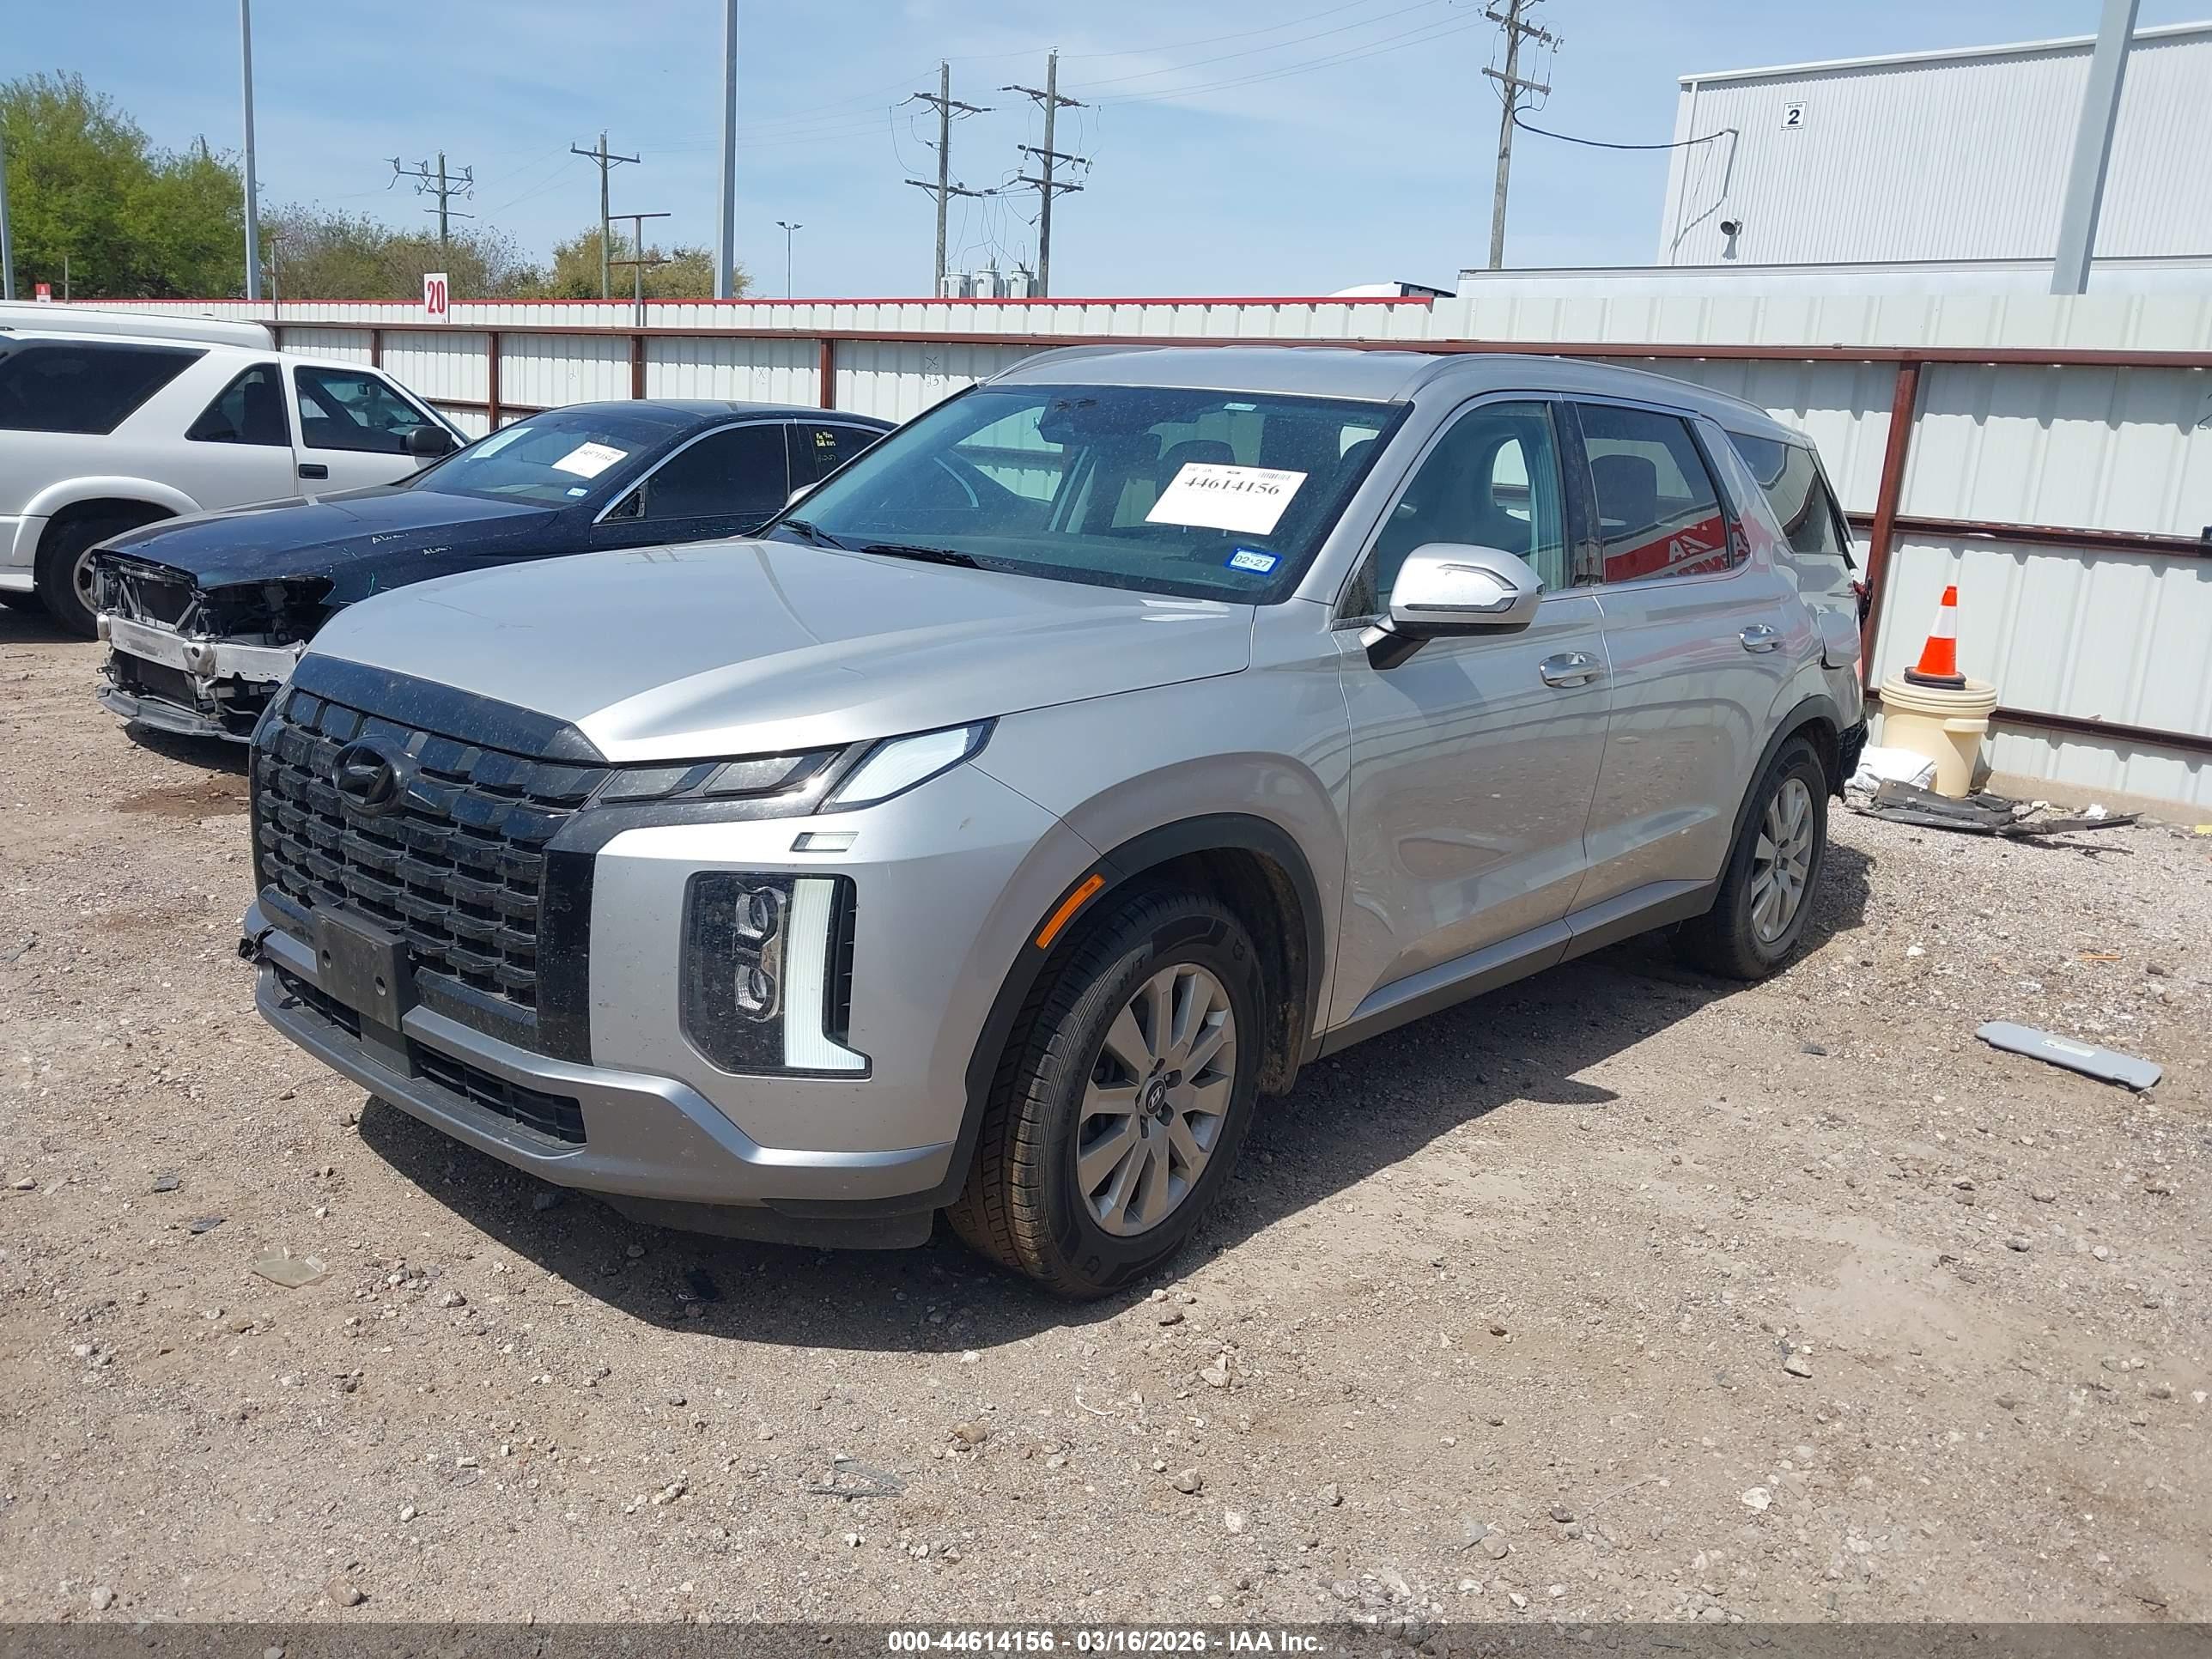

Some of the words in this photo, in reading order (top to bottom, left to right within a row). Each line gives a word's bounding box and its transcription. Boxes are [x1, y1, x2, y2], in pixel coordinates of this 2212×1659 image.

[1787, 109, 1801, 125] 2
[427, 280, 446, 314] 20
[1185, 477, 1280, 495] 44614156
